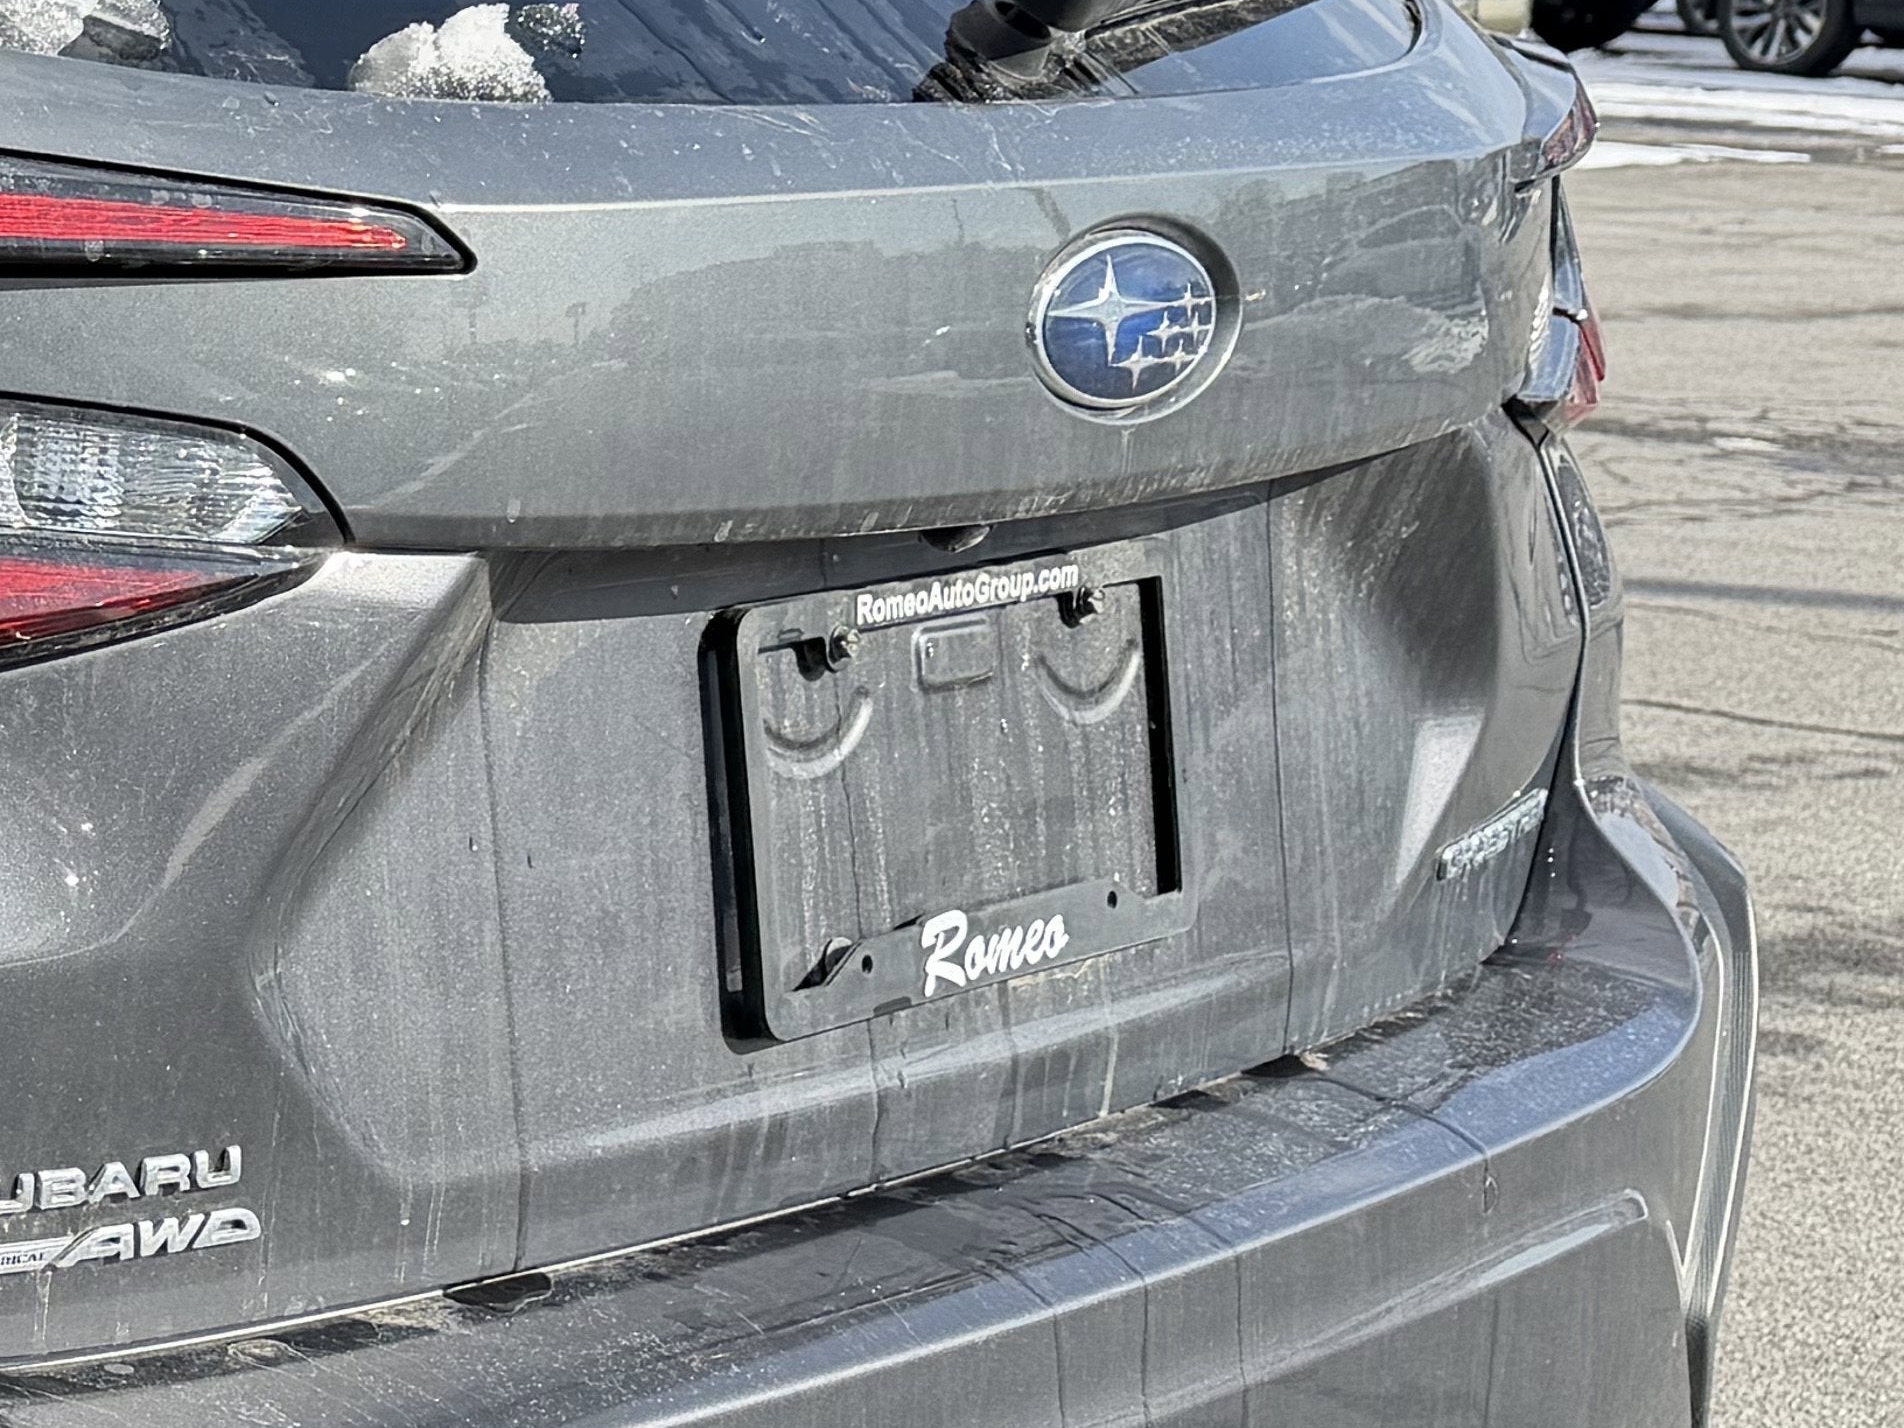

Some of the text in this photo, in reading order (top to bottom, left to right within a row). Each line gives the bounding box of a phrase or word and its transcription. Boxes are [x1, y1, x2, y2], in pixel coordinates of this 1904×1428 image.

[856, 564, 1079, 626] RomeoAutoGroup.com
[921, 909, 1070, 998] Romeo
[42, 1207, 262, 1270] AWD
